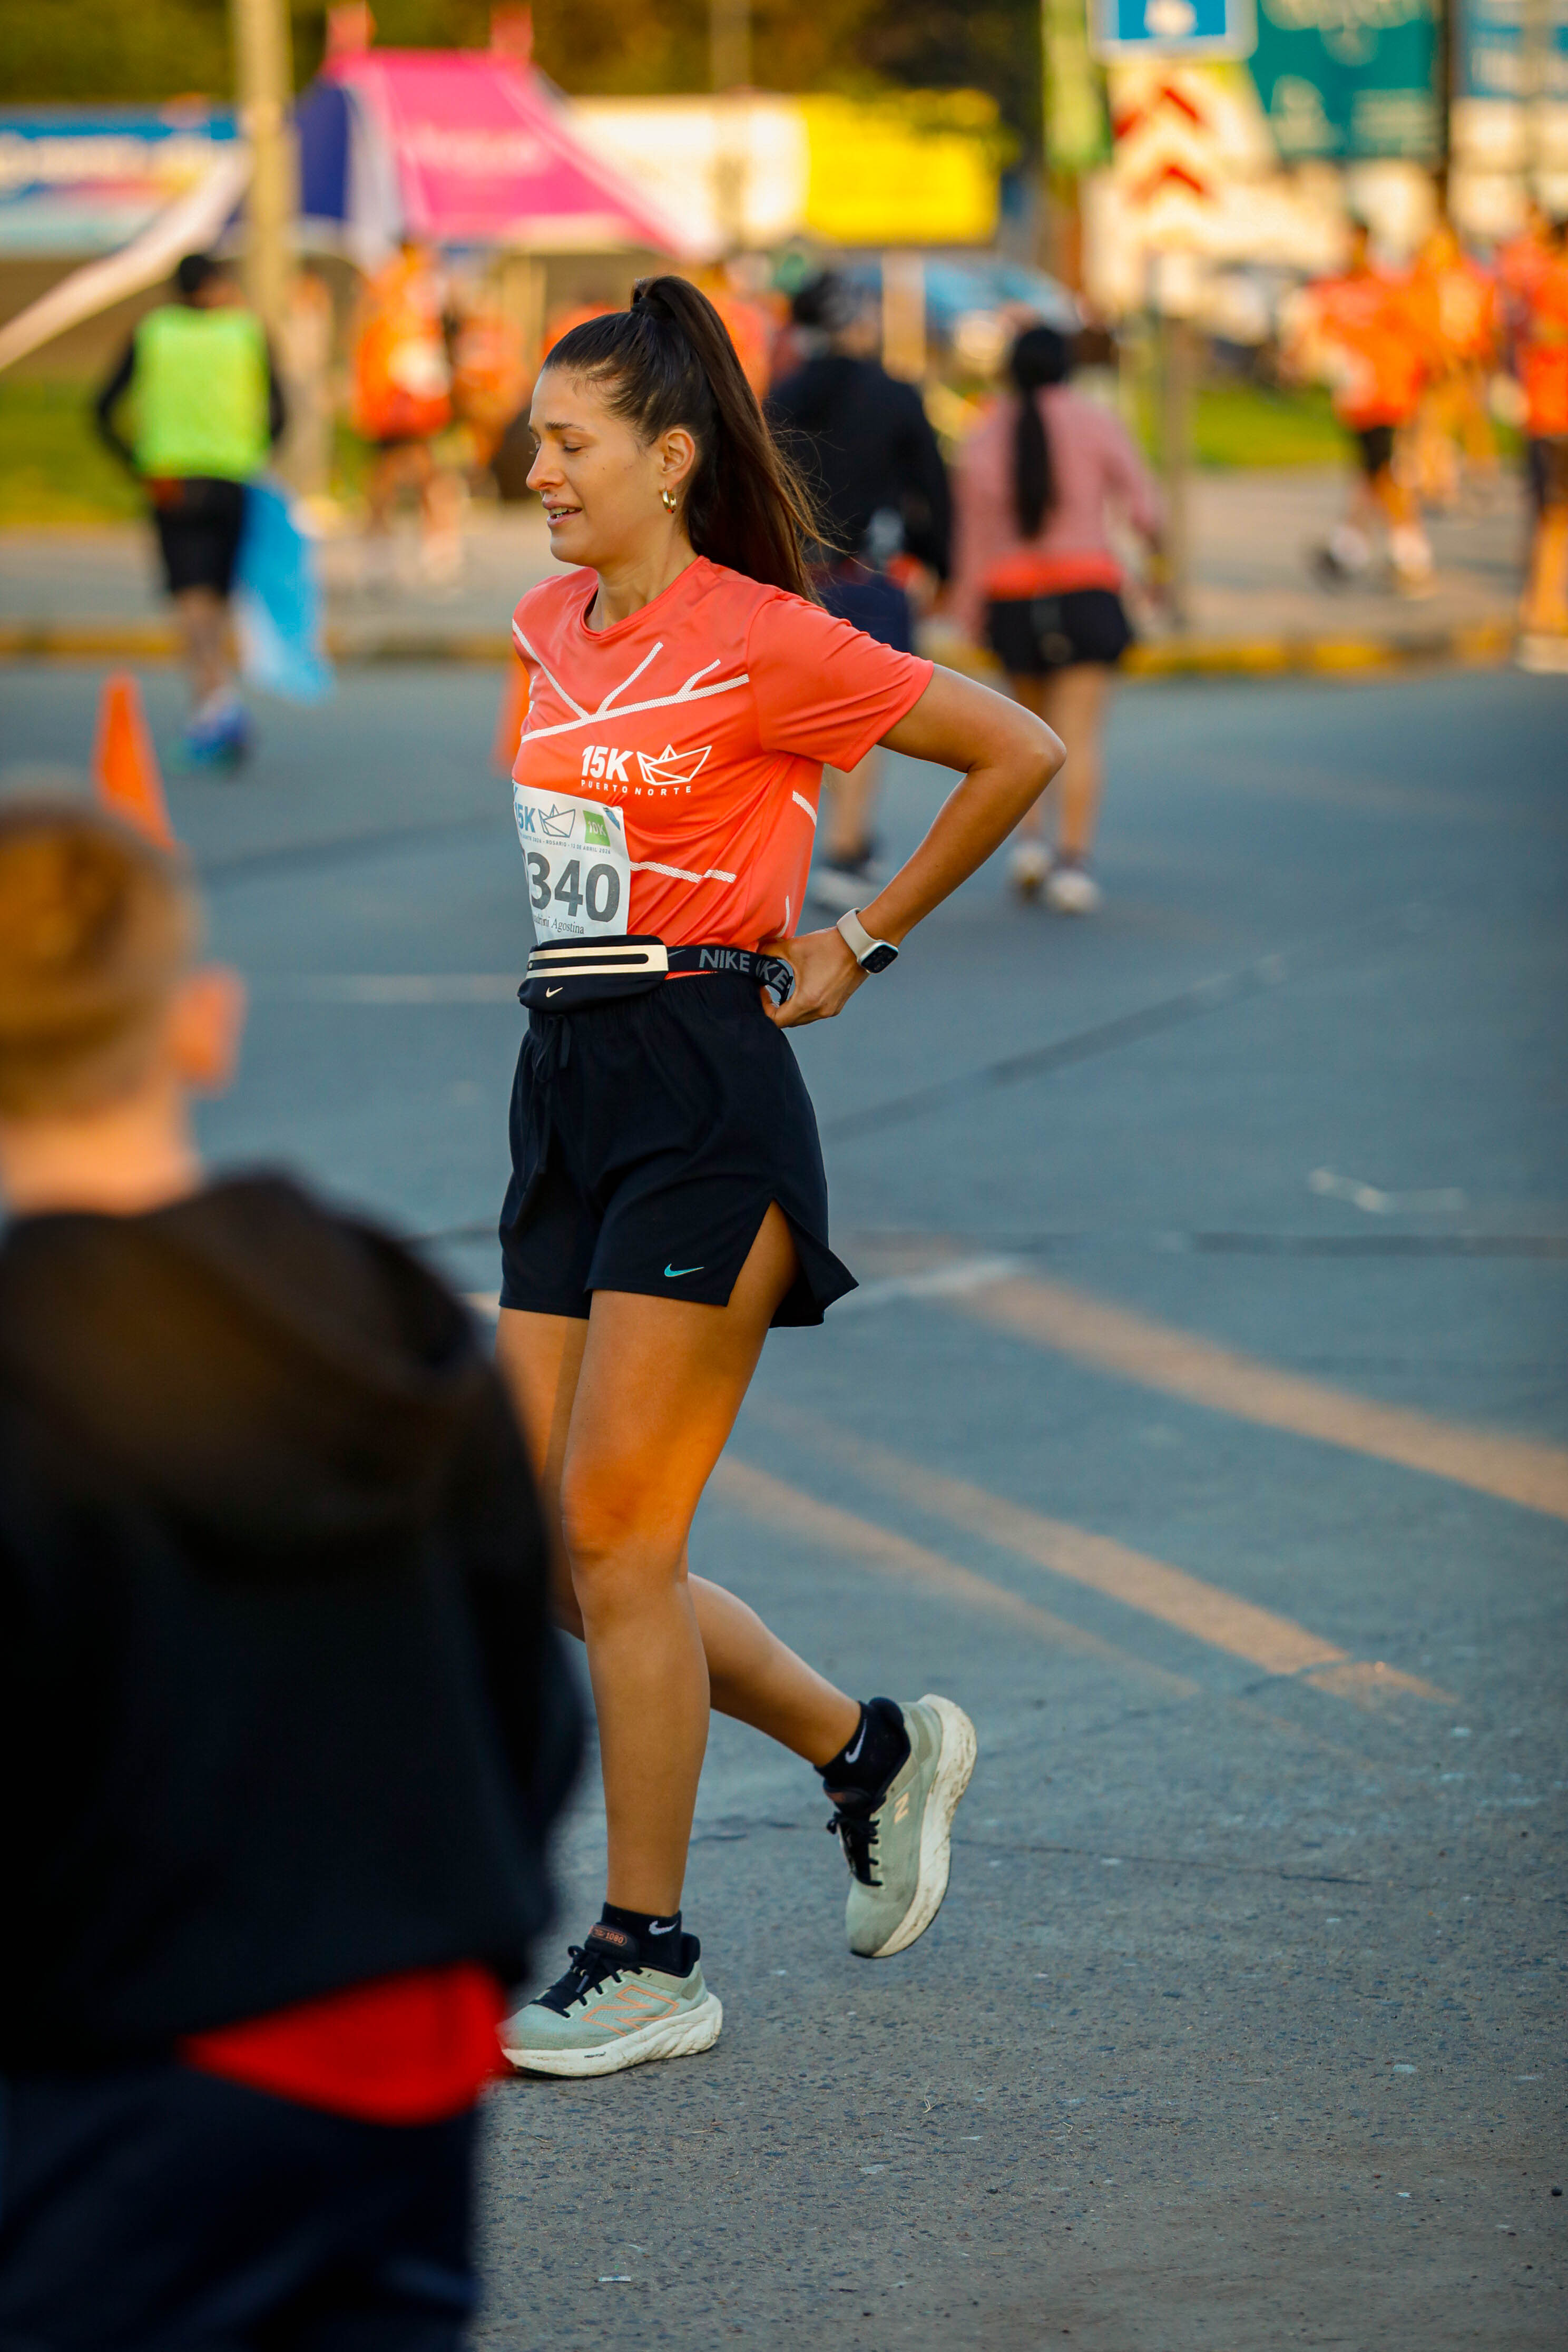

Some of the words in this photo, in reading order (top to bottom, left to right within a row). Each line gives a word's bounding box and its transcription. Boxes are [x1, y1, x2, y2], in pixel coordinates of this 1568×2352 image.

[581, 745, 634, 782] 15K
[588, 821, 606, 836] 10K
[527, 851, 621, 923] 340
[551, 918, 585, 935] Agostina
[699, 948, 751, 973] NIKE
